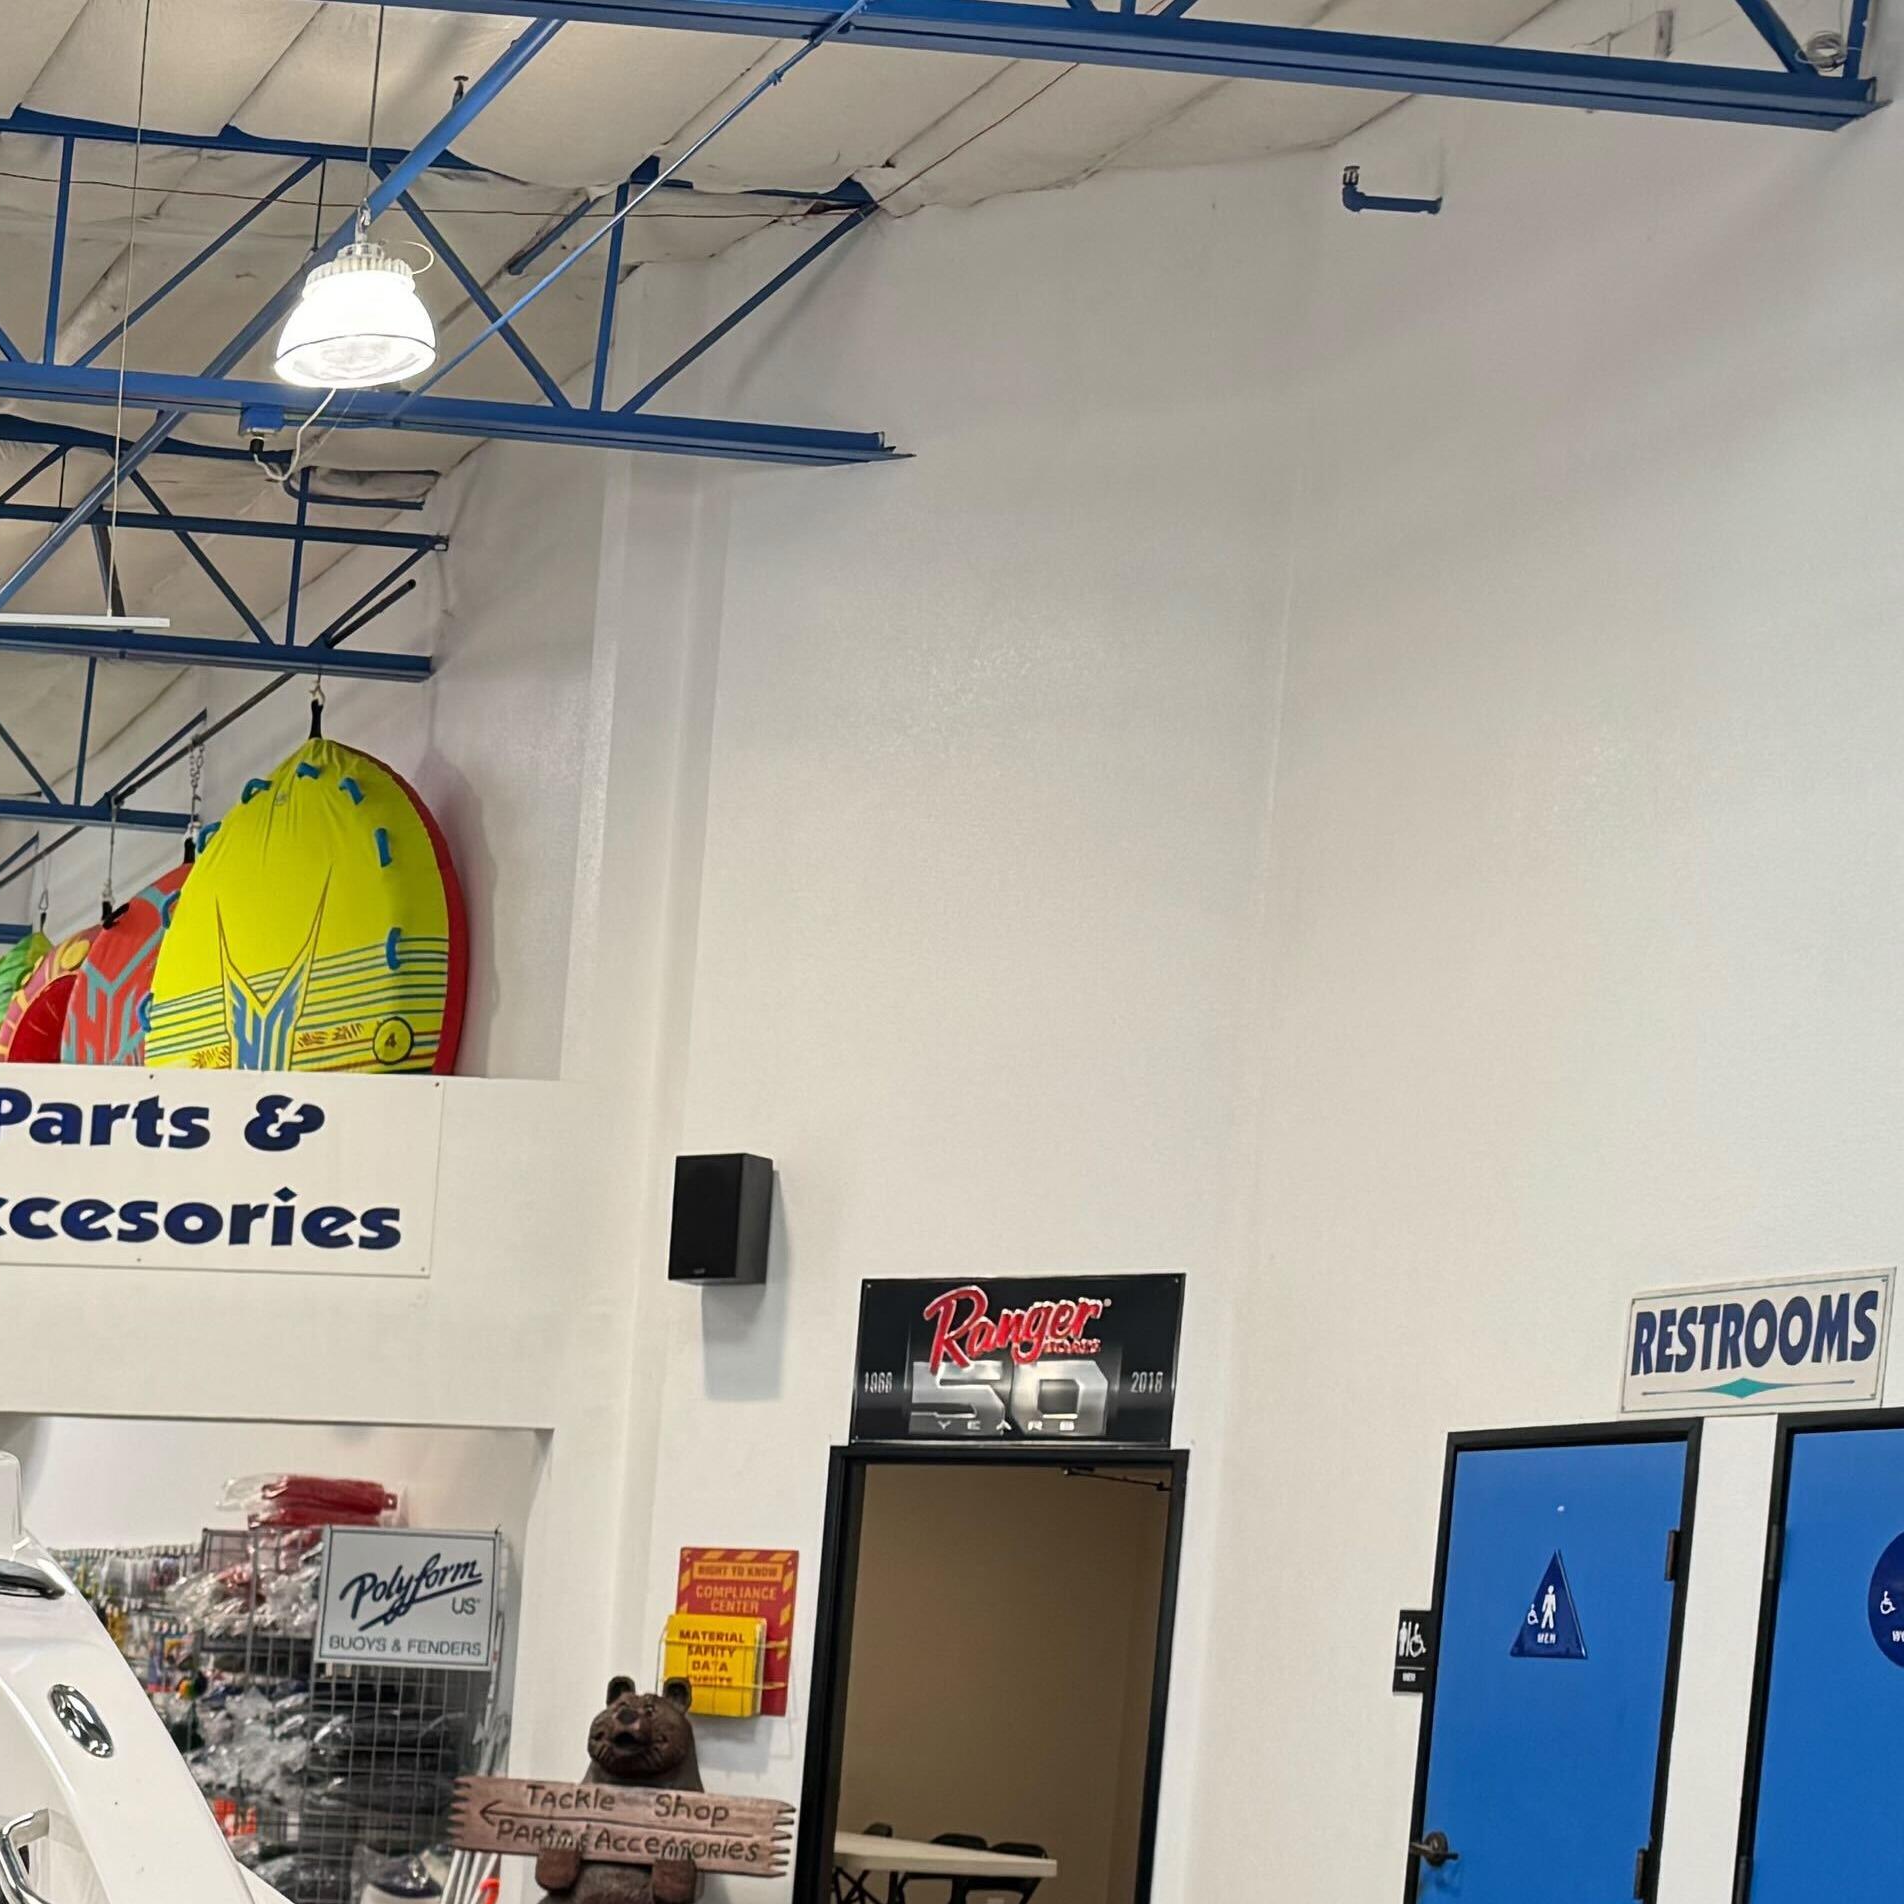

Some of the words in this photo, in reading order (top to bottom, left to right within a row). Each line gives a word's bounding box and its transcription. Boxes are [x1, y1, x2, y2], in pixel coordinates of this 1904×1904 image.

[244, 1094, 326, 1152] &
[923, 1285, 1103, 1376] Ranger
[1630, 1289, 1880, 1376] RESTROOMS
[909, 1359, 1109, 1435] 50
[1130, 1370, 1163, 1394] 2018
[339, 1552, 484, 1632] Polyform
[695, 1584, 778, 1601] COMPLIANCE
[452, 1597, 476, 1616] US
[710, 1599, 759, 1615] CENTER
[328, 1634, 387, 1652] BUOYS
[392, 1639, 402, 1652] &
[407, 1639, 482, 1657] FENDERS
[679, 1629, 745, 1644] MATERIAL
[687, 1644, 737, 1658] SAFETY
[692, 1660, 729, 1672] DATA
[654, 1792, 731, 1828] Shop
